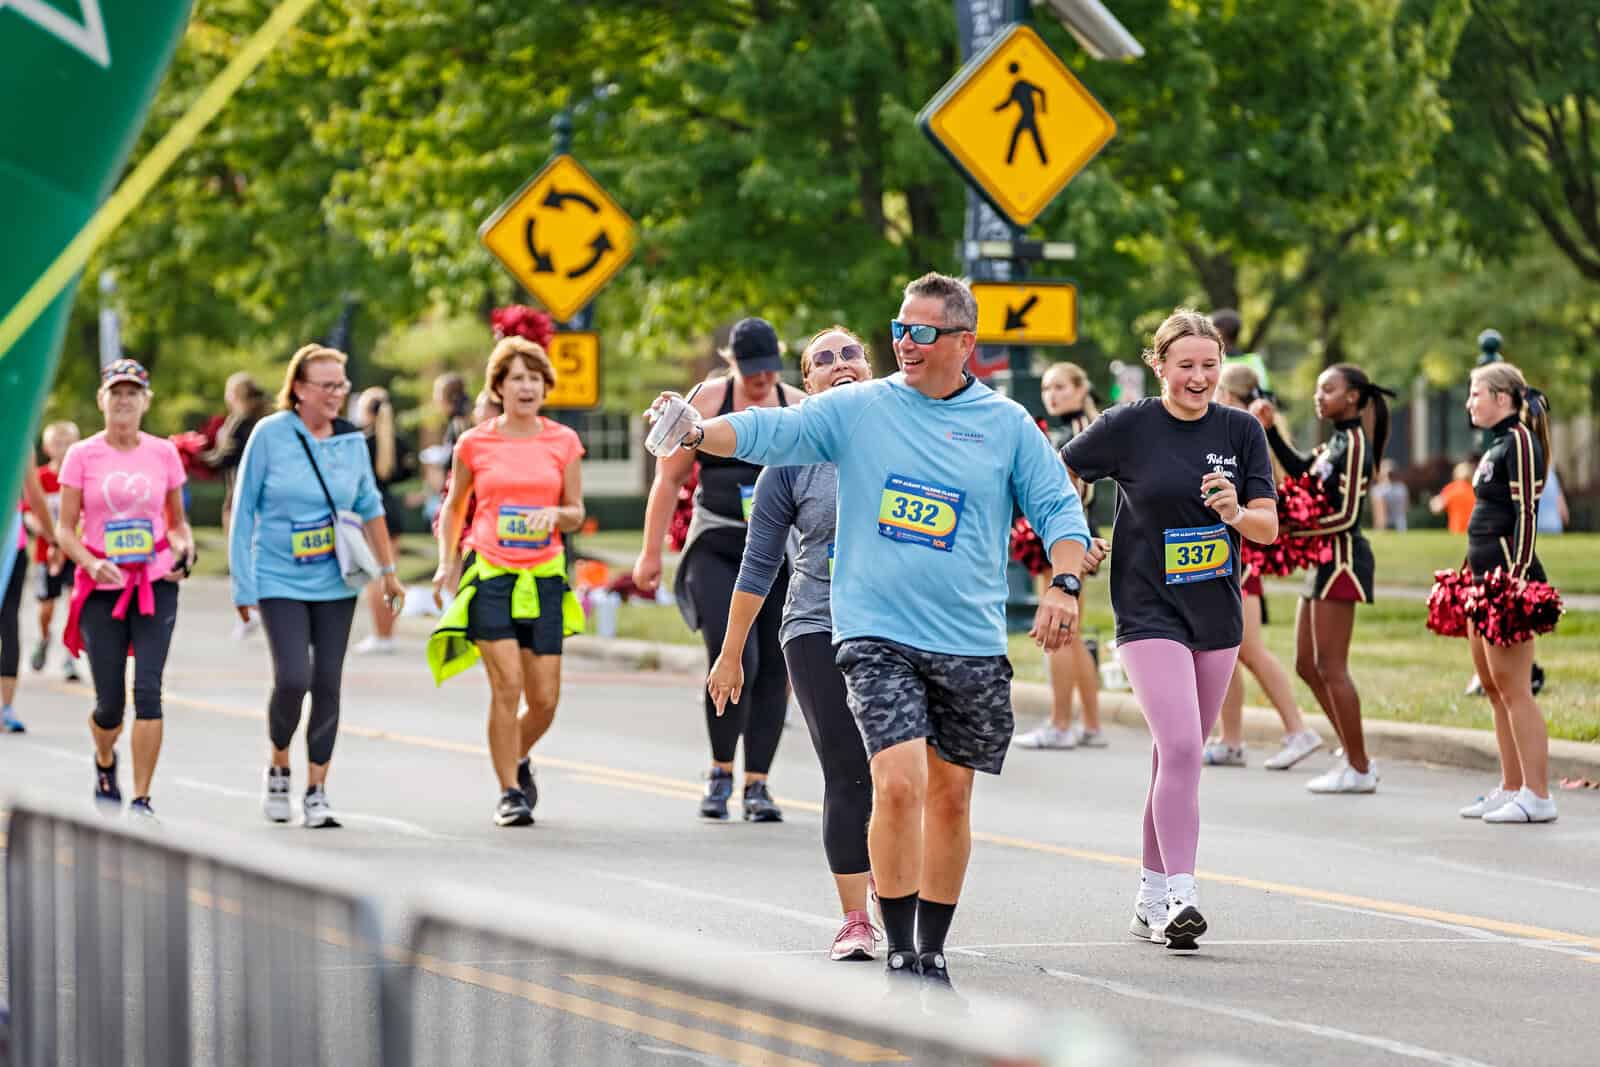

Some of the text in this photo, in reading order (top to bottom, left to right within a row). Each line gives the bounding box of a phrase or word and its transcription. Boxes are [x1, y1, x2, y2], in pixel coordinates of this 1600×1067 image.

[892, 496, 940, 526] 332
[115, 534, 145, 549] 485
[301, 532, 331, 549] 484
[1177, 544, 1216, 566] 337
